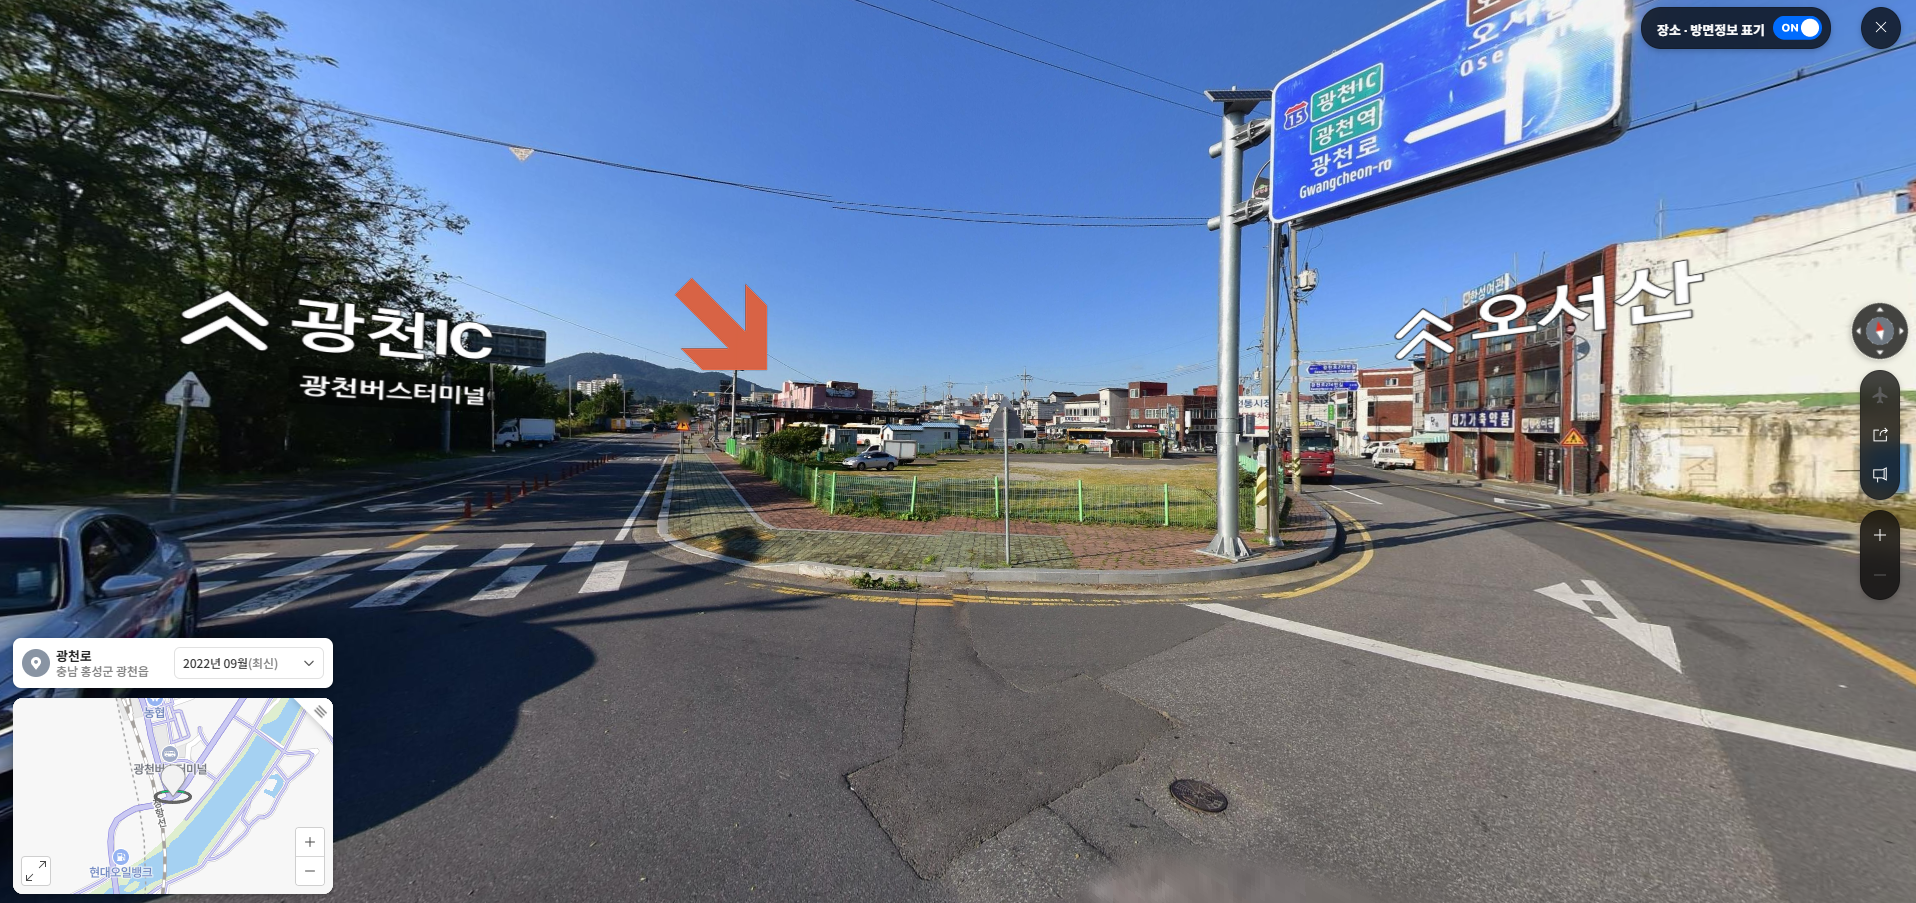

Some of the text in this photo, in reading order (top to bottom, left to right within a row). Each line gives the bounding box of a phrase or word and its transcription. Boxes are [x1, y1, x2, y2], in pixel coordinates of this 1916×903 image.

[1316, 71, 1378, 112] 광천IC
[1289, 112, 1304, 126] 15
[1315, 106, 1377, 146] 광천역
[1310, 135, 1381, 177] 광천로
[1300, 158, 1392, 199] Gwangcheon-ro
